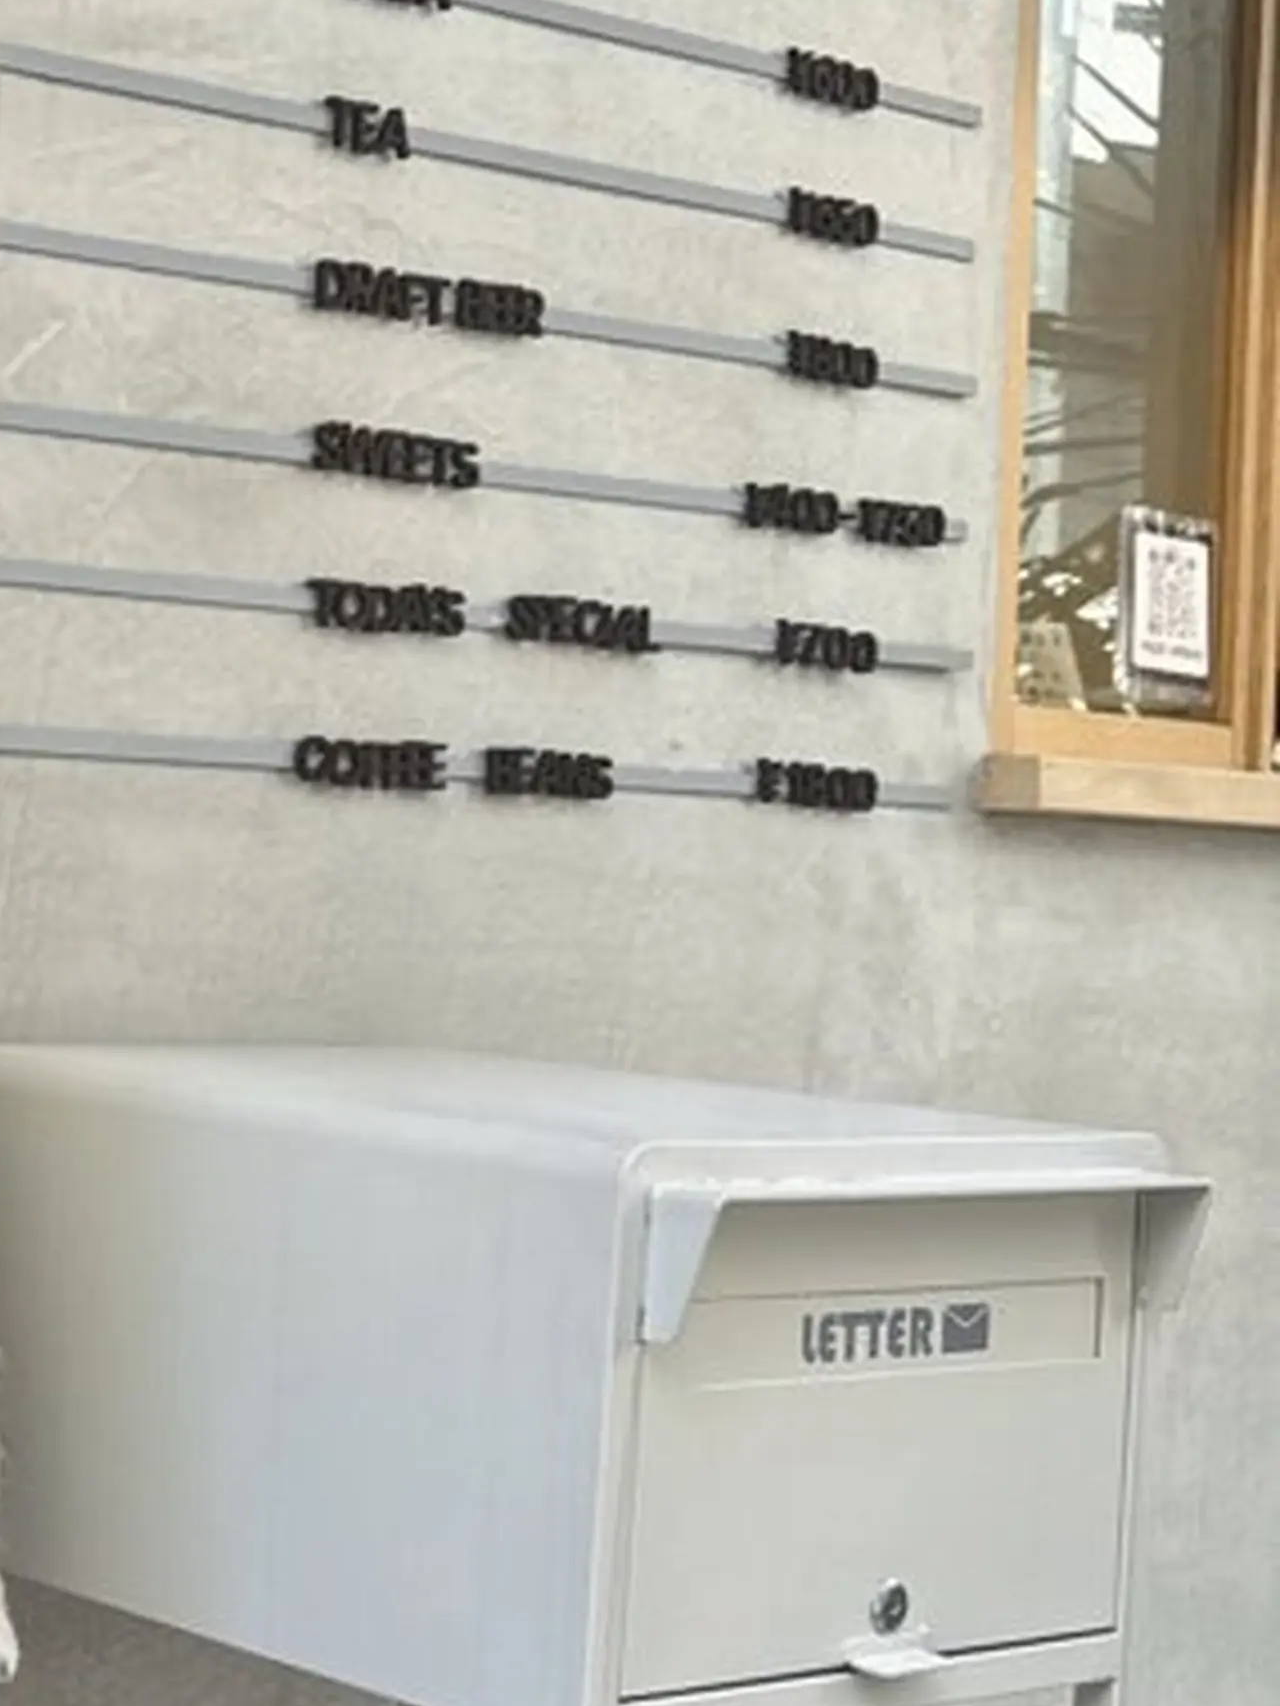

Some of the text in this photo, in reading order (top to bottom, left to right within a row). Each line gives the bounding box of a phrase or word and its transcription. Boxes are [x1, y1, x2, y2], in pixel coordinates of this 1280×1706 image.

[323, 95, 412, 160] TEA
[313, 259, 451, 326] DRAFT
[308, 421, 480, 490] SWEETS
[501, 595, 662, 656] SPECIAL
[290, 735, 447, 792] COFFEE
[480, 747, 615, 801] BEANS
[802, 1307, 934, 1364] LETTER
